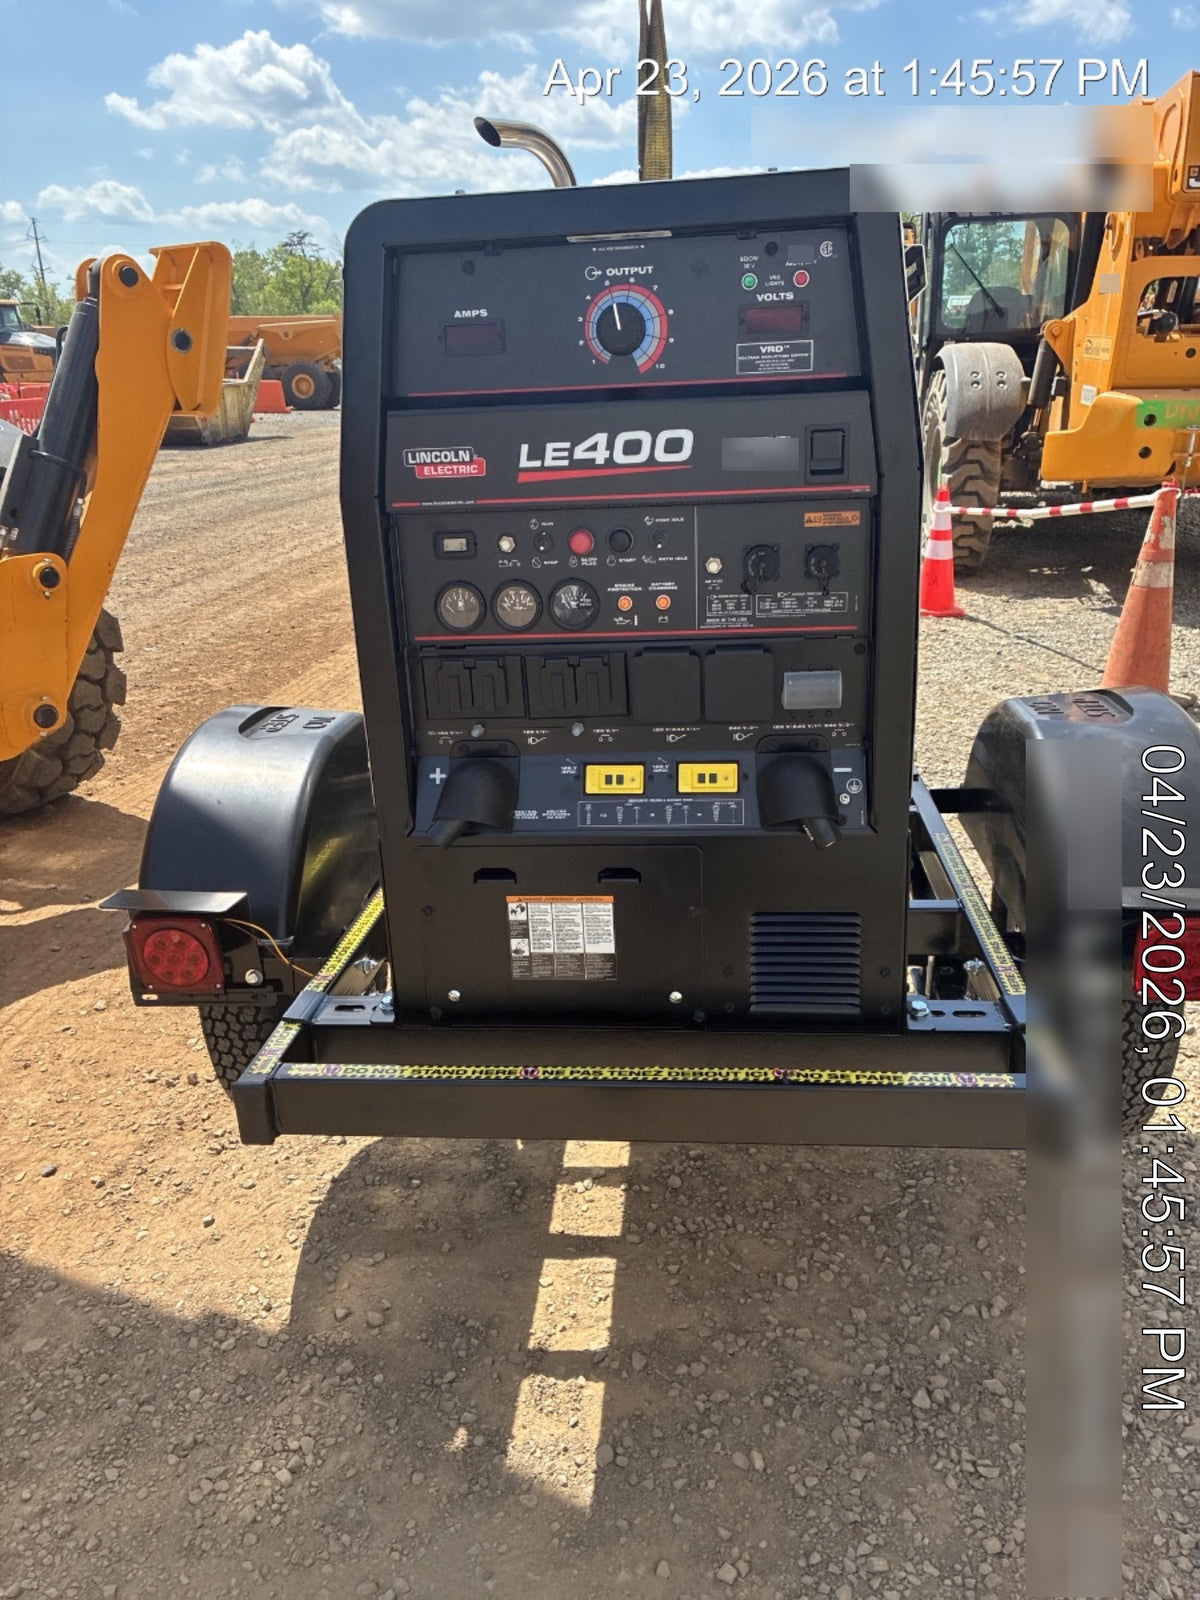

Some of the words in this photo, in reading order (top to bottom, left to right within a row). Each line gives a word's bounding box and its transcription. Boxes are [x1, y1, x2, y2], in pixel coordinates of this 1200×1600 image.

[606, 265, 654, 276] OUTPUT
[756, 292, 794, 302] VOLTS
[454, 308, 488, 318] AMPS
[519, 429, 694, 468] LE400
[408, 449, 470, 464] LINCOLN
[424, 465, 478, 475] ELECTRIC
[1004, 972, 1023, 992] HERE
[343, 1066, 369, 1075] DO
[372, 1066, 407, 1075] NOT
[411, 1067, 467, 1076] STAND
[471, 1067, 519, 1076] HERE
[542, 1068, 565, 1077] NE
[569, 1068, 604, 1077] PAS
[609, 1069, 664, 1077] TENEZ
[667, 1069, 739, 1078] DEBOUT
[745, 1070, 769, 1078] ICI
[797, 1071, 821, 1079] NO
[827, 1072, 852, 1080] SE
[855, 1073, 904, 1082] PARE
